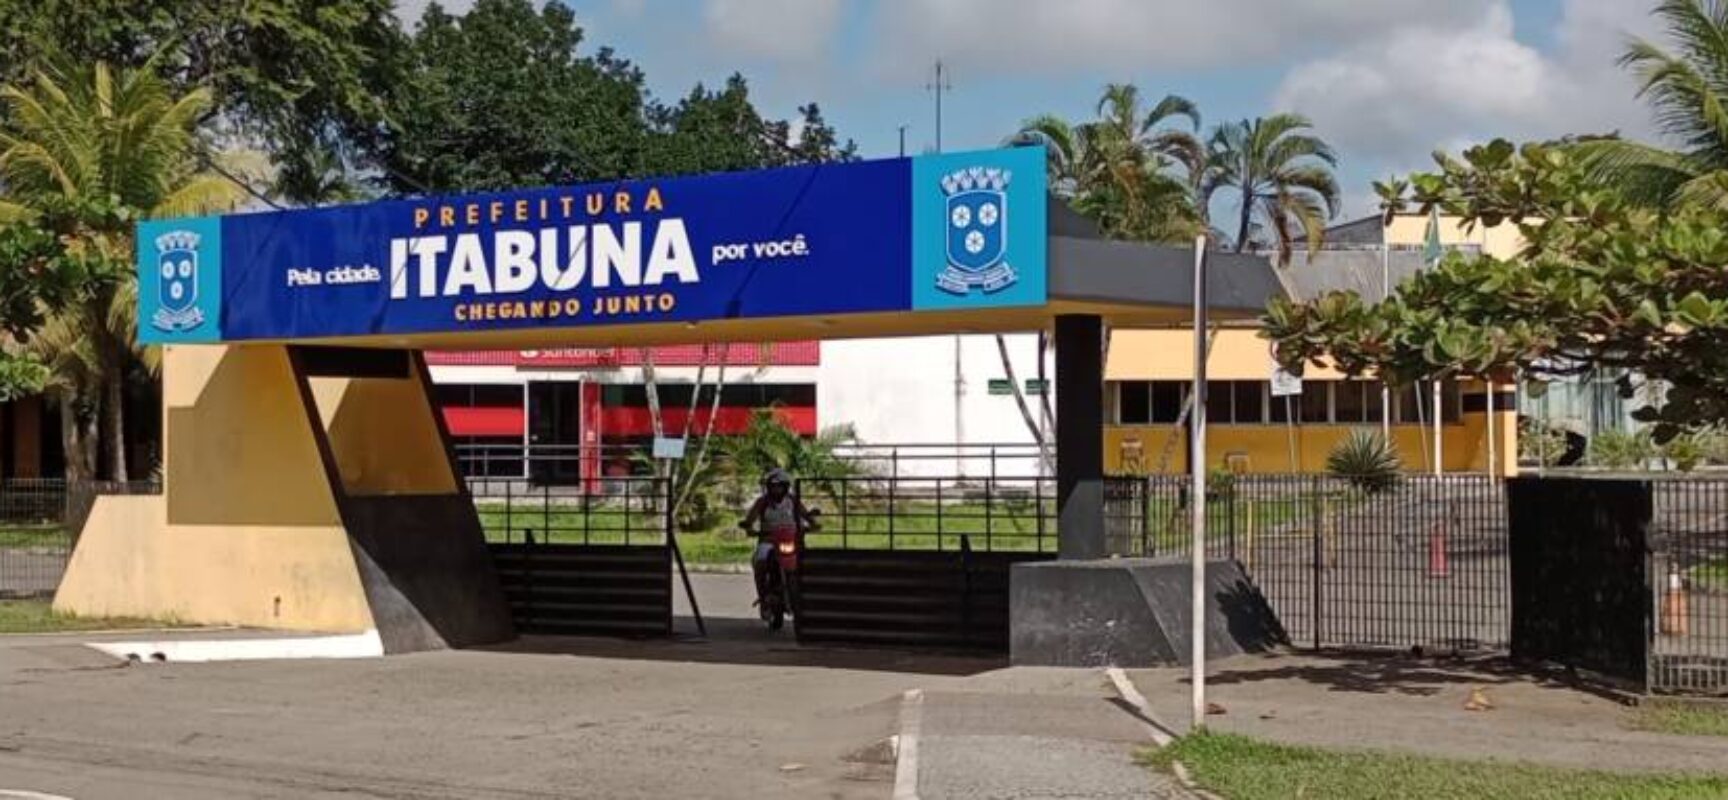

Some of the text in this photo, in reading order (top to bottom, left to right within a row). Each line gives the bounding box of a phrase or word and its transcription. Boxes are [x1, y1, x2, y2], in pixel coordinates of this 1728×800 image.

[415, 188, 663, 228] PREFEITURA
[390, 218, 699, 299] ITABUNA
[712, 233, 809, 265] por você.
[287, 267, 321, 286] Pela
[454, 293, 675, 320] CHEGANDO JUNTO
